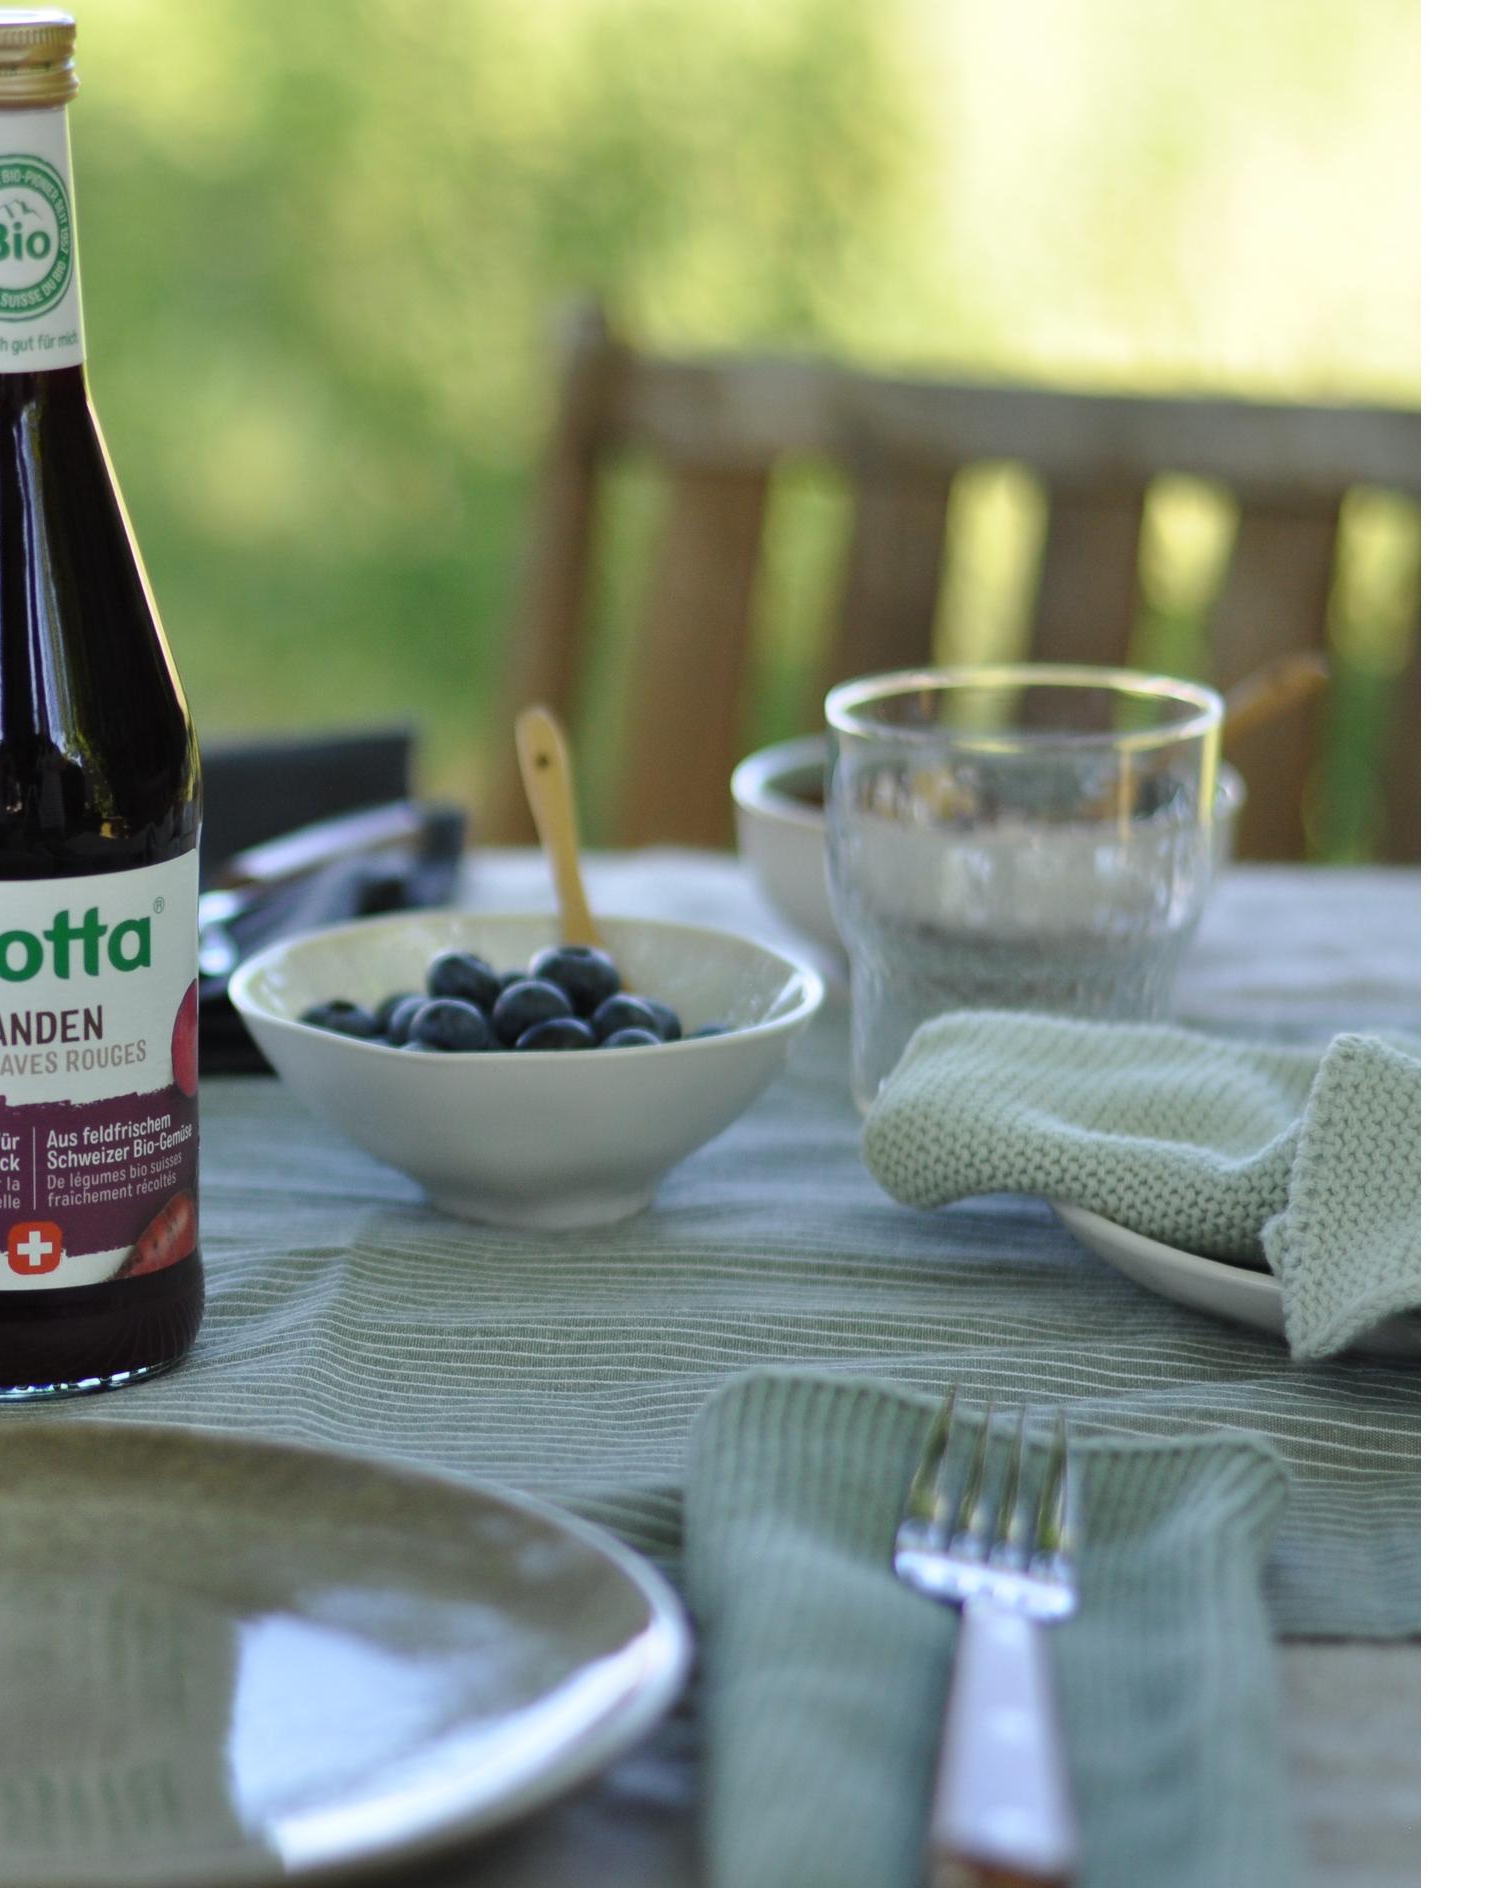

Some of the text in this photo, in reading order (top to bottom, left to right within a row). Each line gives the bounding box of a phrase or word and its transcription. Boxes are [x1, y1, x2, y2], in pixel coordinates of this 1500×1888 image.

[0, 292, 42, 309] SUISSE
[42, 281, 57, 300] DU
[52, 260, 67, 282] BIO
[11, 335, 34, 356] gut
[37, 332, 56, 350] für
[66, 1039, 147, 1073] ROUGES
[46, 1113, 171, 1149] Aus feldfrischem
[47, 1123, 193, 1170] Schweizer Bio-Gemüse
[6, 1176, 21, 1192] la
[47, 1152, 183, 1190] De légumes bio suisses
[48, 1170, 177, 1208] fraîchement récoltés
